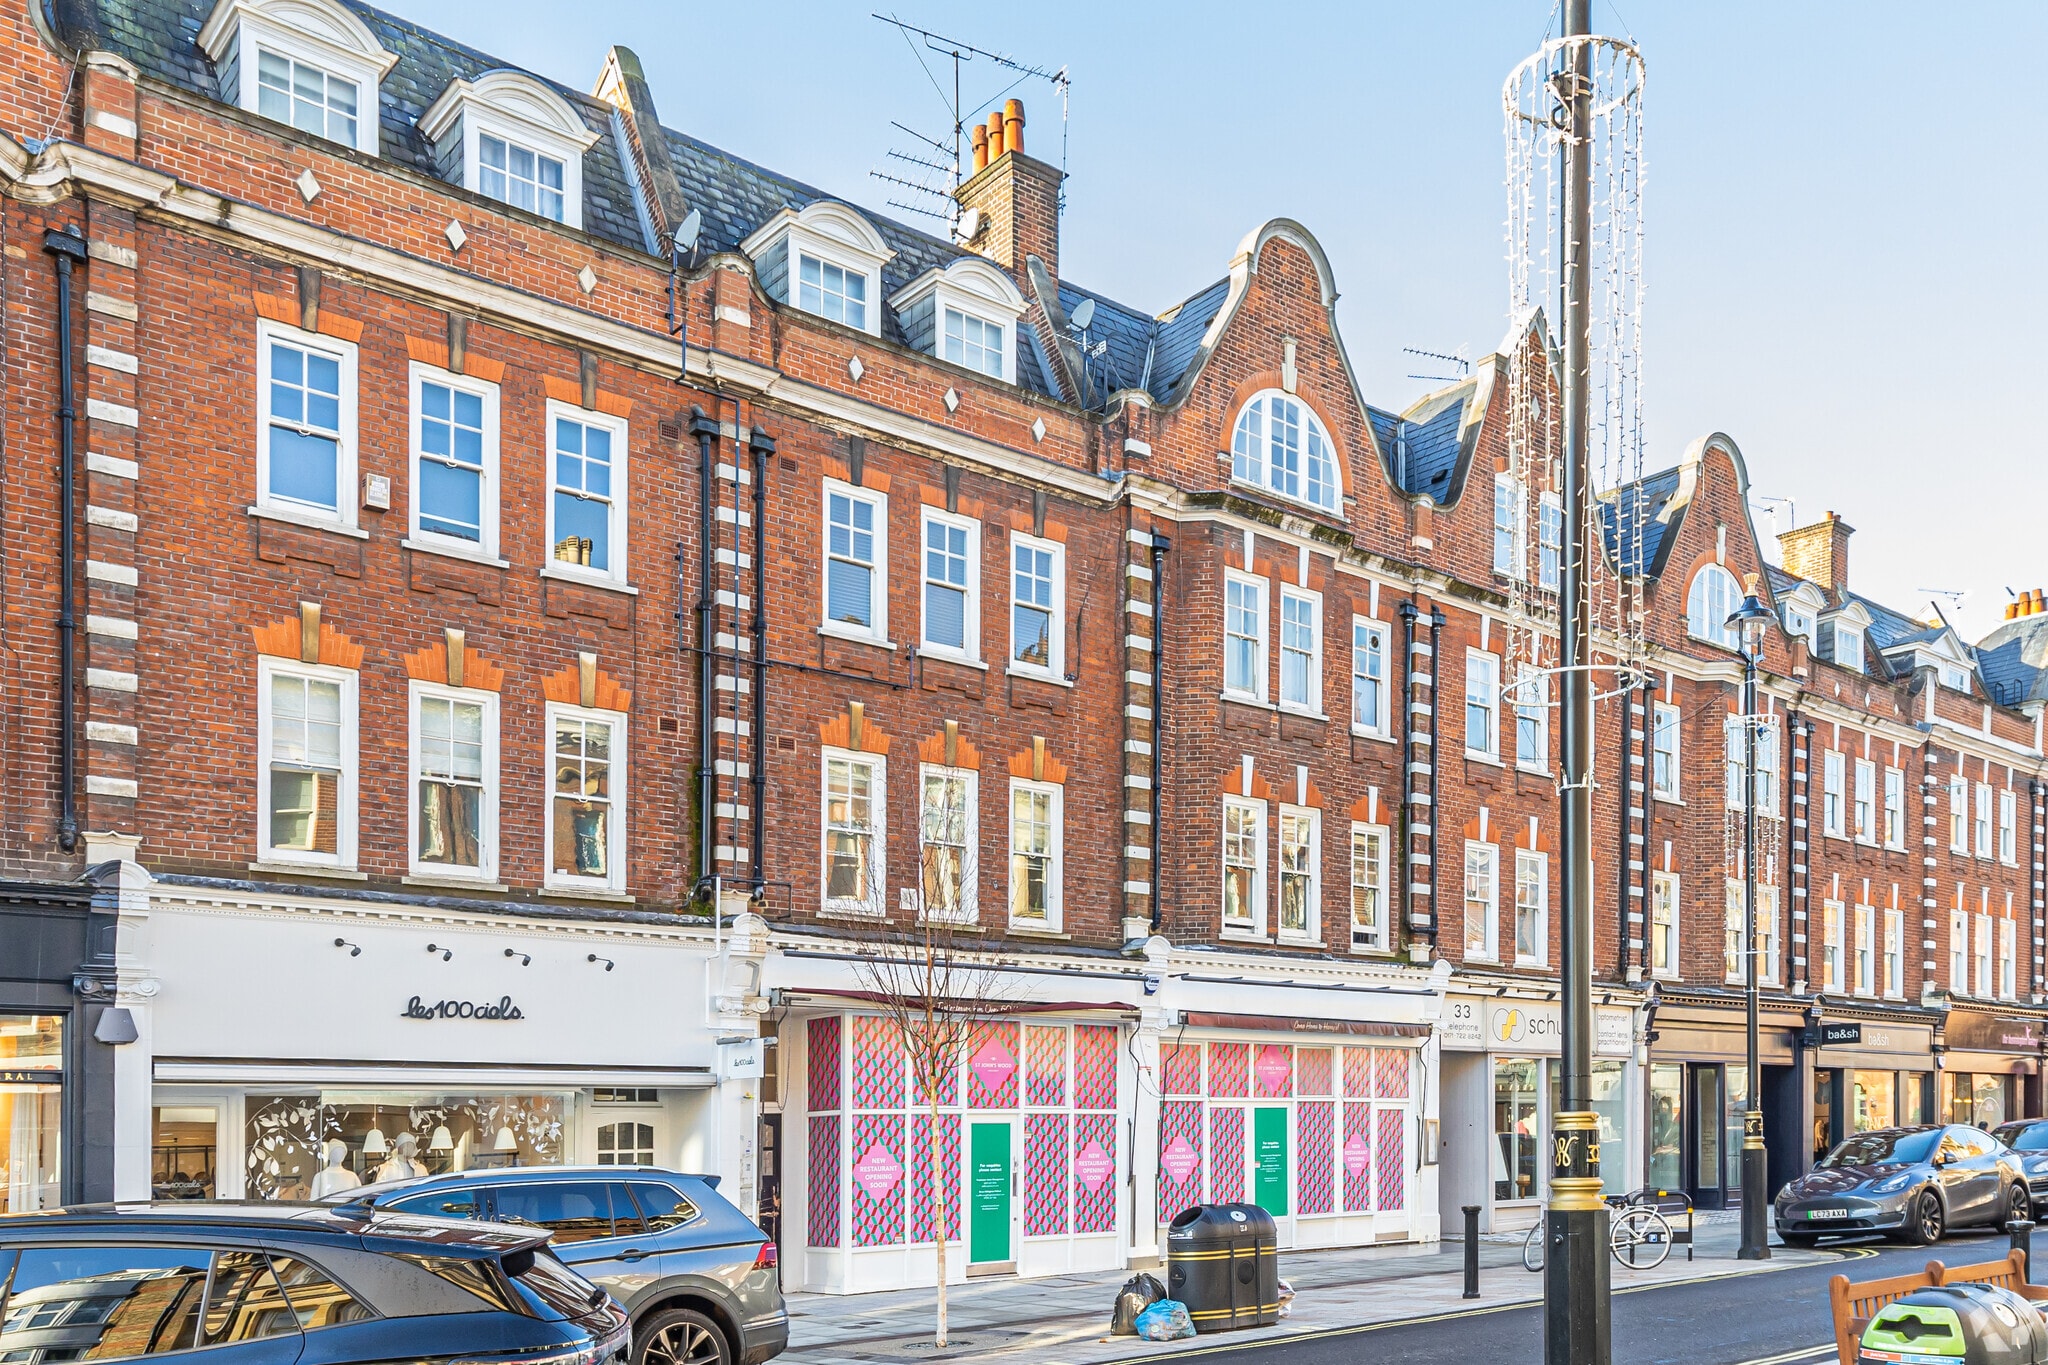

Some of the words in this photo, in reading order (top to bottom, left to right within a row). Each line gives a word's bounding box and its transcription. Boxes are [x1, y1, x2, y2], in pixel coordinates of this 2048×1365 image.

[1455, 1004, 1471, 1018] 33
[1827, 1028, 1859, 1040] ba&sh
[1867, 1032, 1890, 1046] ba&sh
[0, 1072, 33, 1081] RAL
[864, 1173, 893, 1181] OPENING
[870, 1181, 888, 1189] SOON
[1832, 1209, 1846, 1217] AXA
